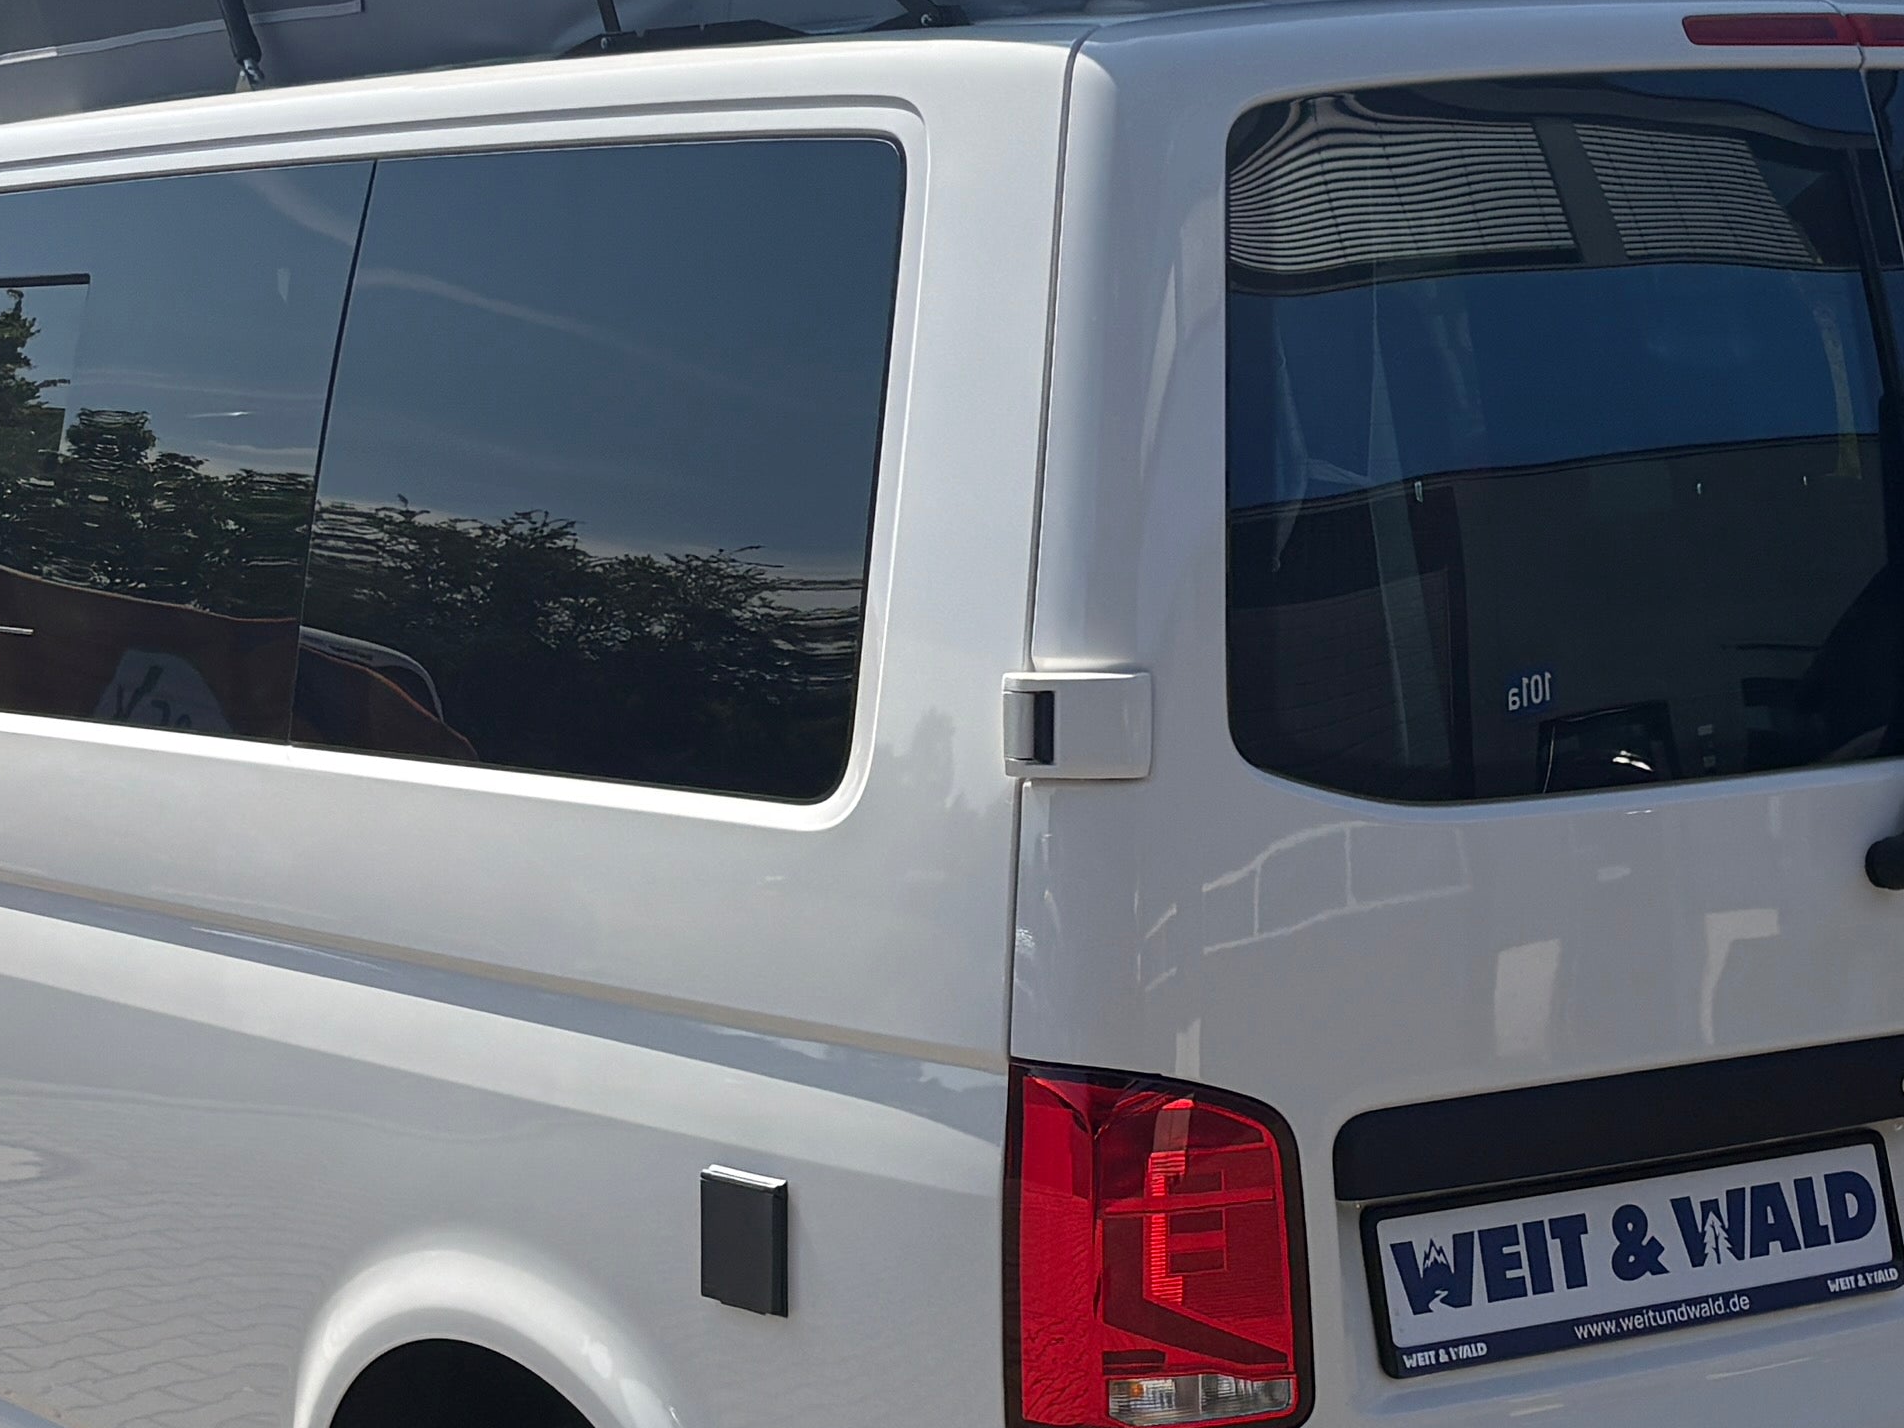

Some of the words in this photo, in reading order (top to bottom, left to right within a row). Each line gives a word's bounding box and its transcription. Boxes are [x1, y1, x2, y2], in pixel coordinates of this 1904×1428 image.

[1390, 1213, 1589, 1315] WEIT
[1611, 1204, 1671, 1281] &
[1670, 1171, 1877, 1268] WALD
[1827, 1275, 1856, 1292] WEIT
[1857, 1274, 1866, 1287] &
[1865, 1268, 1899, 1285] WALD
[1574, 1295, 1750, 1340] www.weitundwald.de
[1402, 1350, 1436, 1369] WEIT
[1438, 1348, 1449, 1363] &
[1449, 1342, 1488, 1360] WALD
